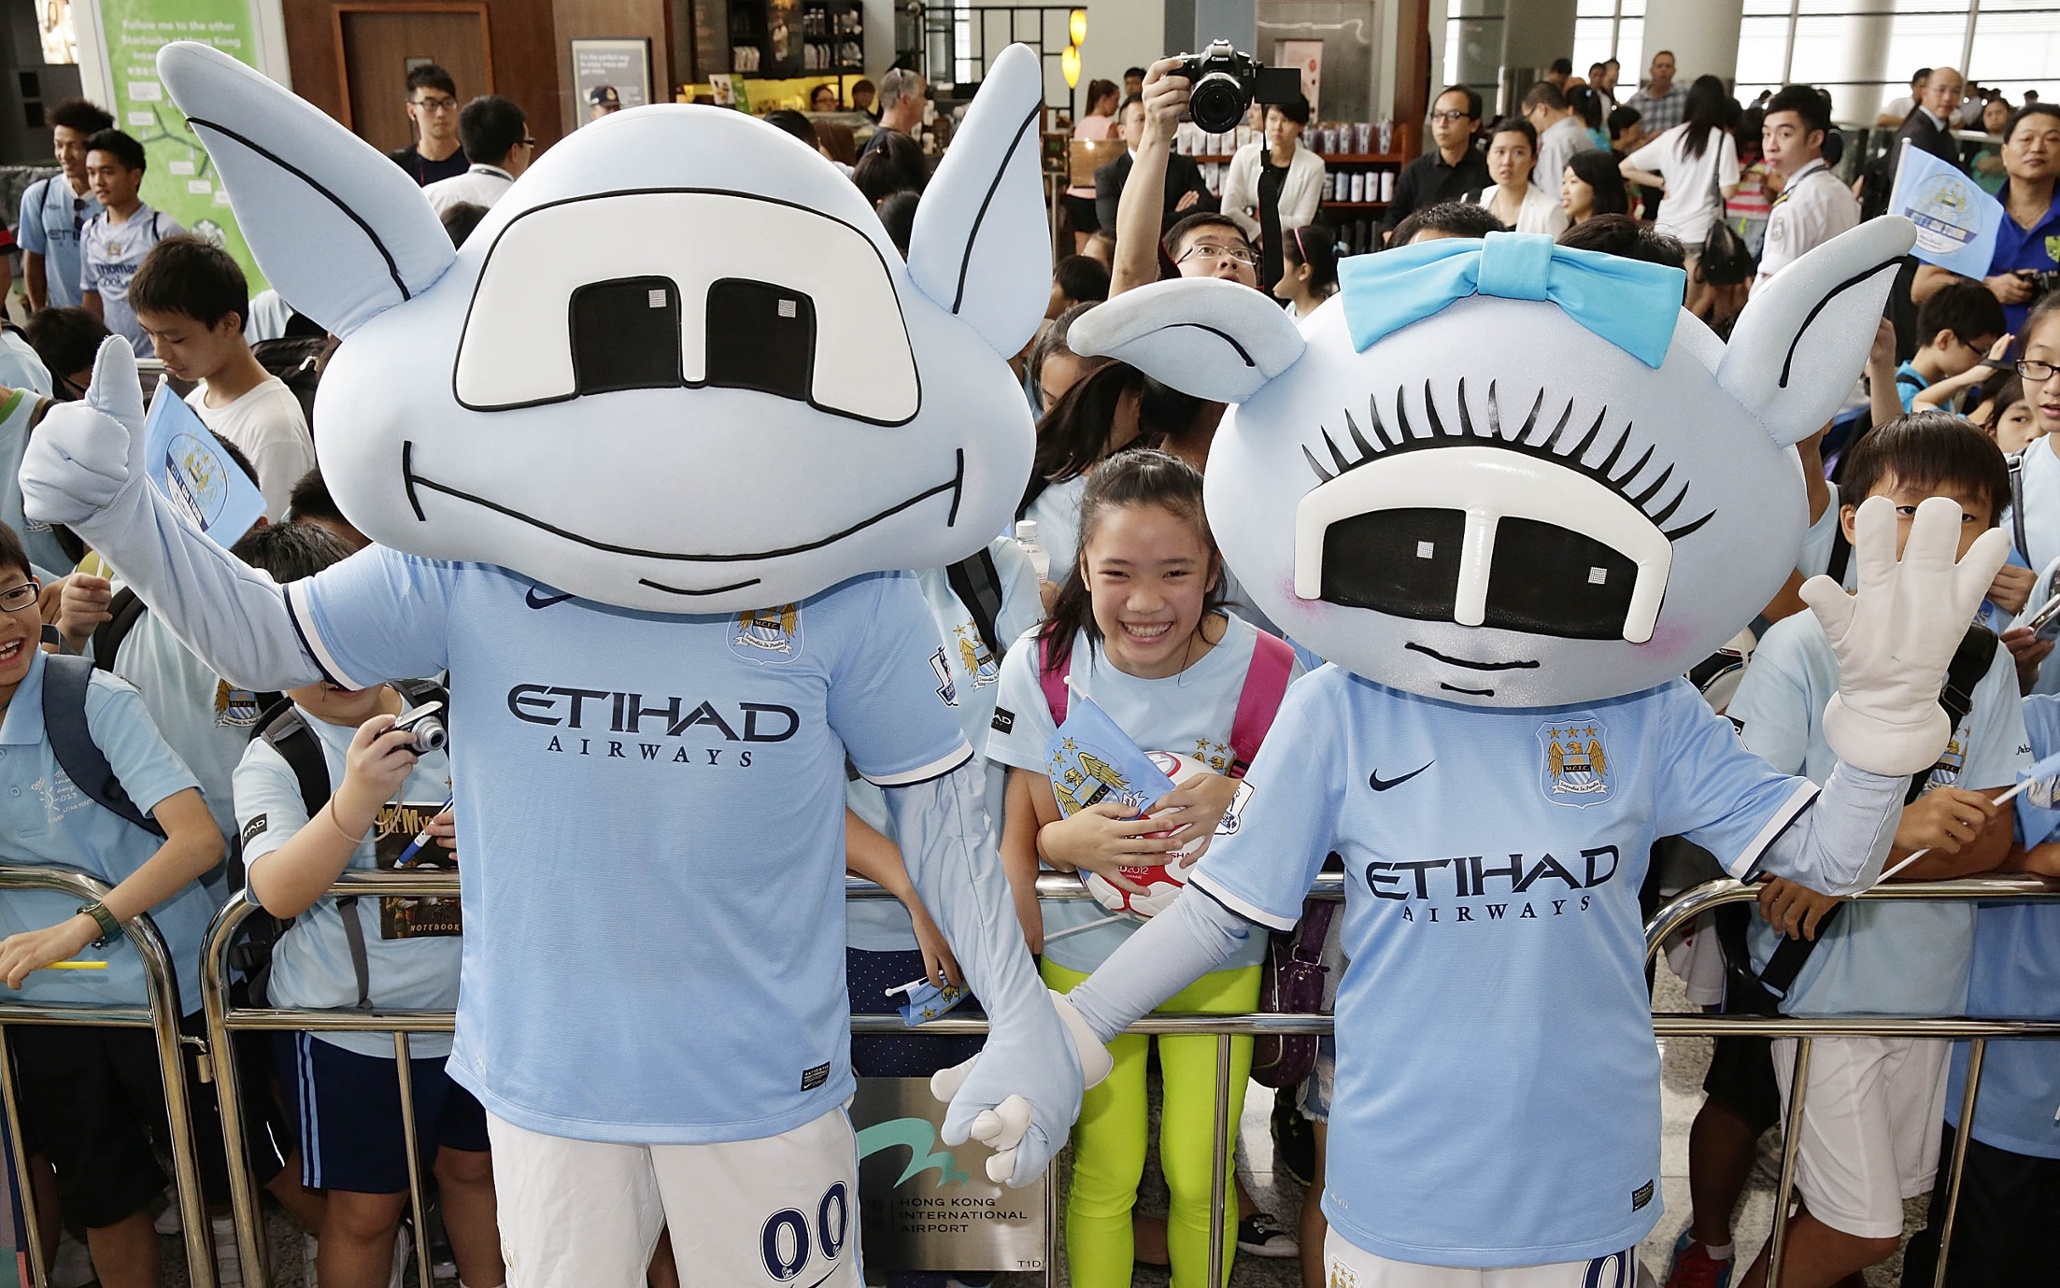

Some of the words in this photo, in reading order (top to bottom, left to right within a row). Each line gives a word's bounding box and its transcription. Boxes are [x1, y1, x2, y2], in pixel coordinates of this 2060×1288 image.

[507, 683, 801, 743] ETIHAD
[547, 735, 752, 768] AIRWAYS
[1365, 844, 1620, 900] ETIHAD
[1402, 895, 1590, 922] AIRWAYS
[409, 923, 460, 932] NOTEBOOK
[900, 1198, 945, 1207] HONG
[951, 1198, 996, 1207] KONG
[901, 1211, 1028, 1219] INTERNATIONAL
[760, 1181, 849, 1282] 00
[901, 1224, 969, 1233] AIRPORT
[1017, 1260, 1042, 1268] T1D
